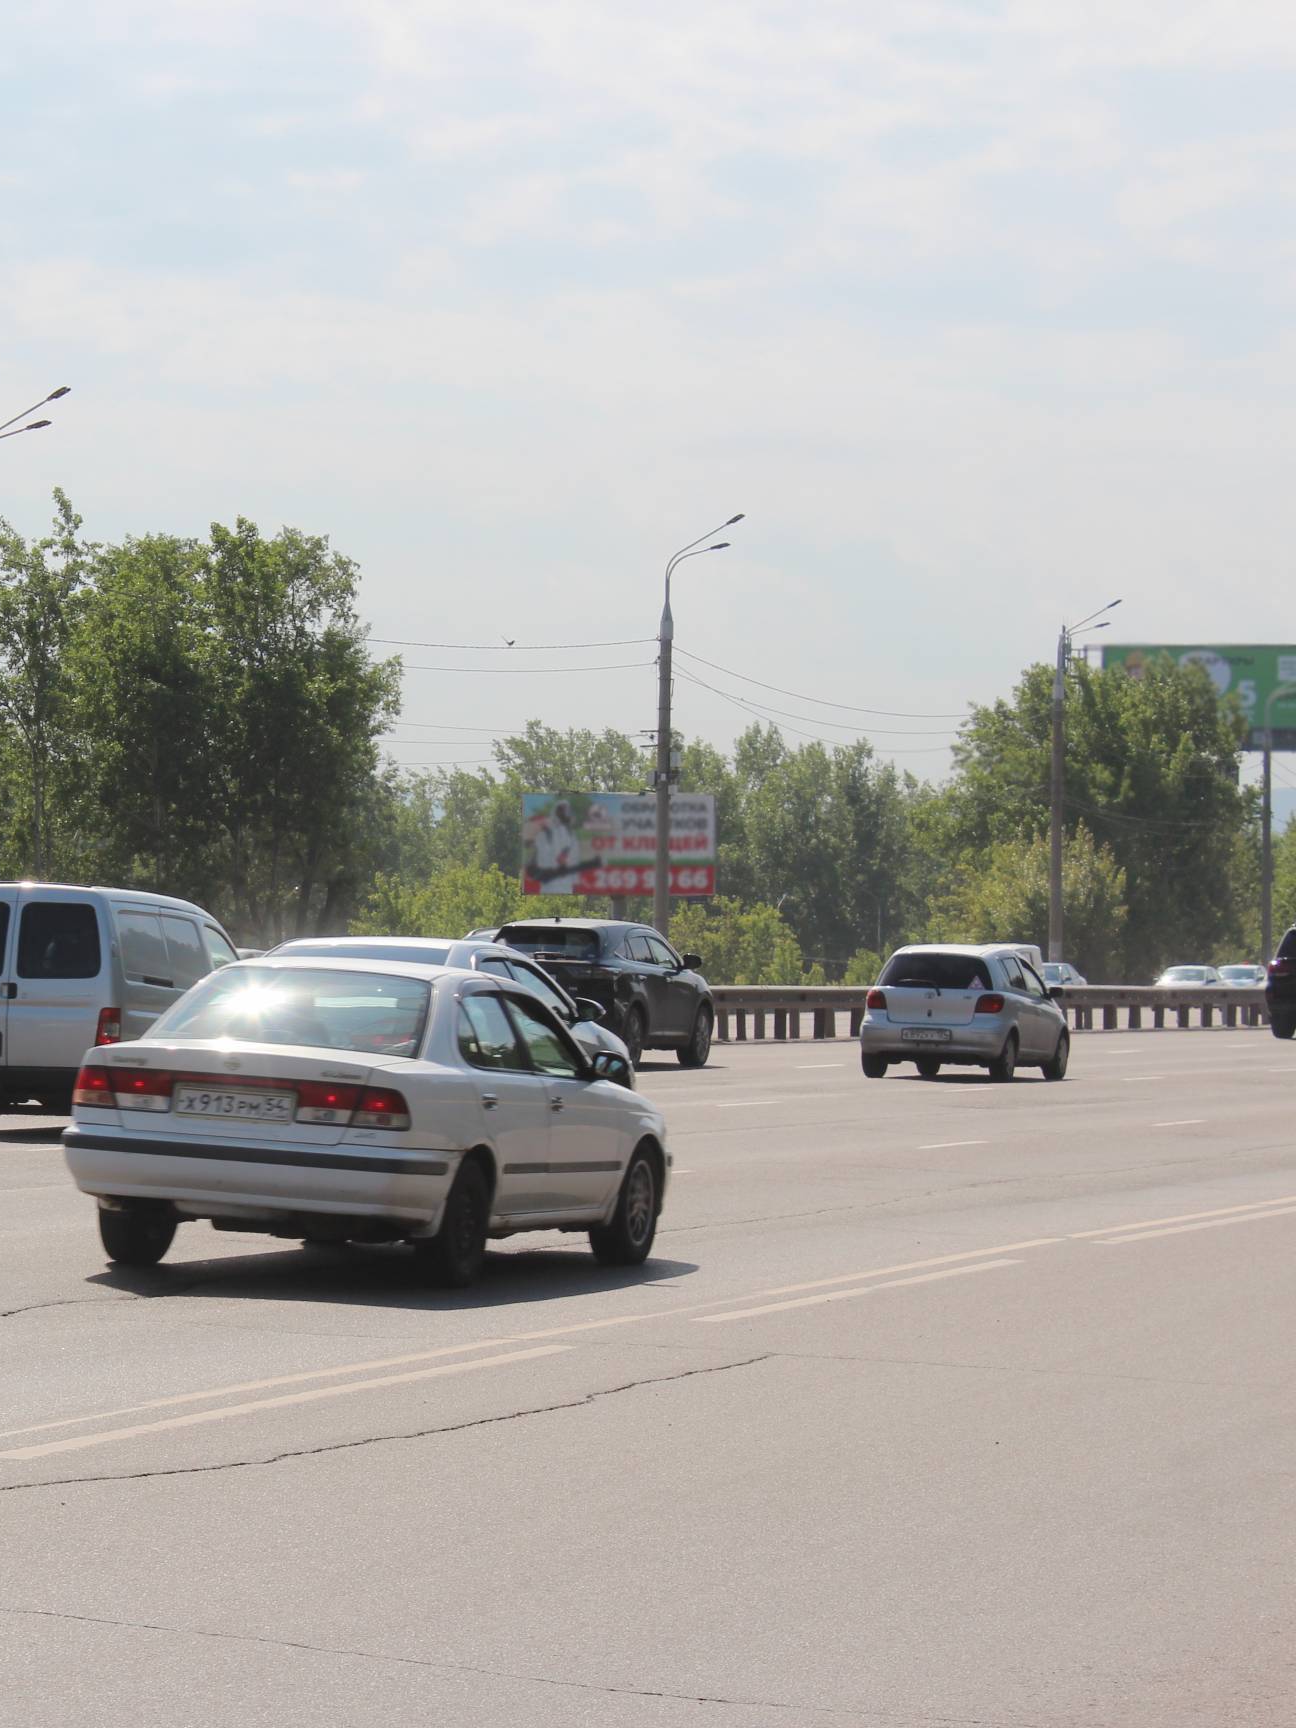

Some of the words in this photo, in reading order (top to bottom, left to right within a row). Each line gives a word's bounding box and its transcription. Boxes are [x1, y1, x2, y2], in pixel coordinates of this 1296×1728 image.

[621, 802, 707, 813] ОБРАОТКА
[591, 835, 616, 850] ОТ
[594, 869, 637, 889] 269
[642, 869, 673, 889] 9
[678, 869, 708, 889] 66
